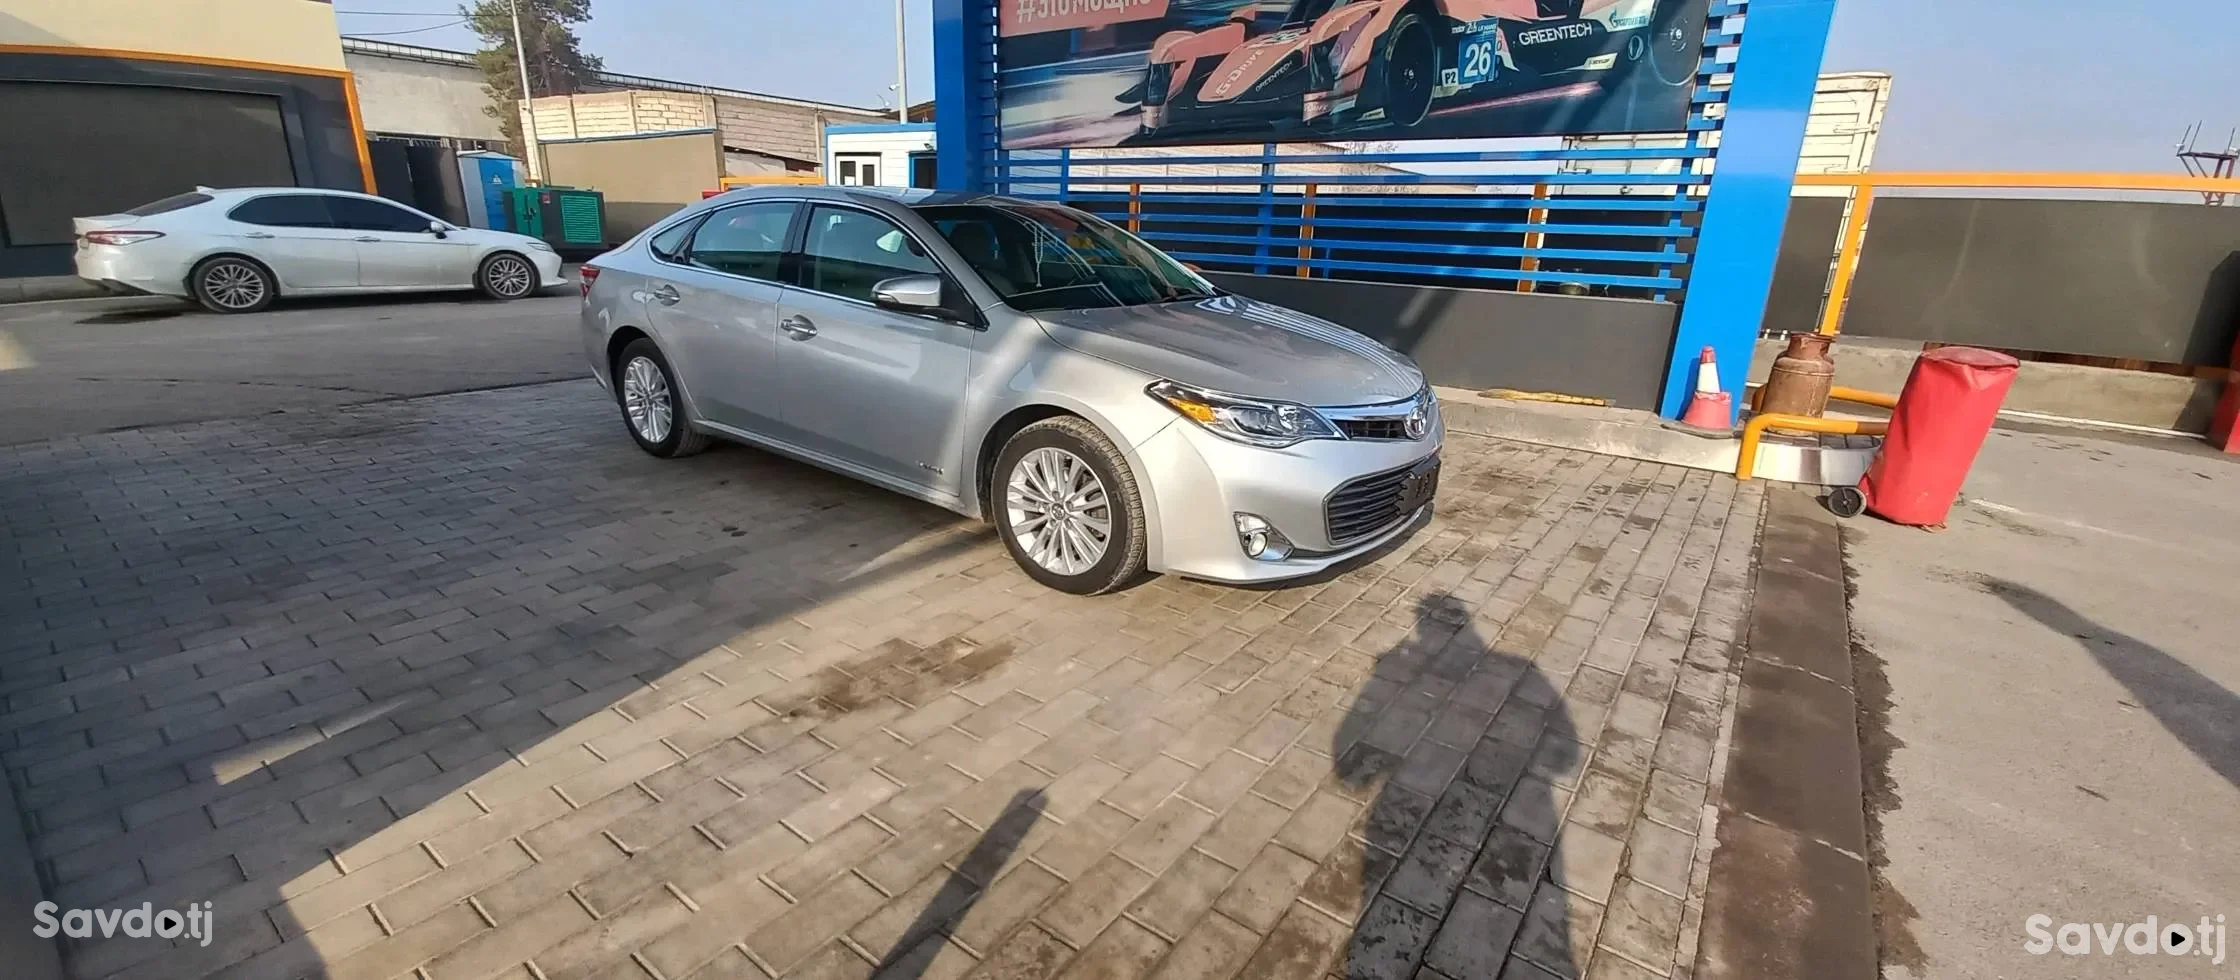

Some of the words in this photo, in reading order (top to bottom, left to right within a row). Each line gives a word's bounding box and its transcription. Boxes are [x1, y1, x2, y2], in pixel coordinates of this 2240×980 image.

[1518, 22, 1593, 46] GREENTECH
[1464, 41, 1492, 78] 26
[1444, 71, 1457, 84] P2
